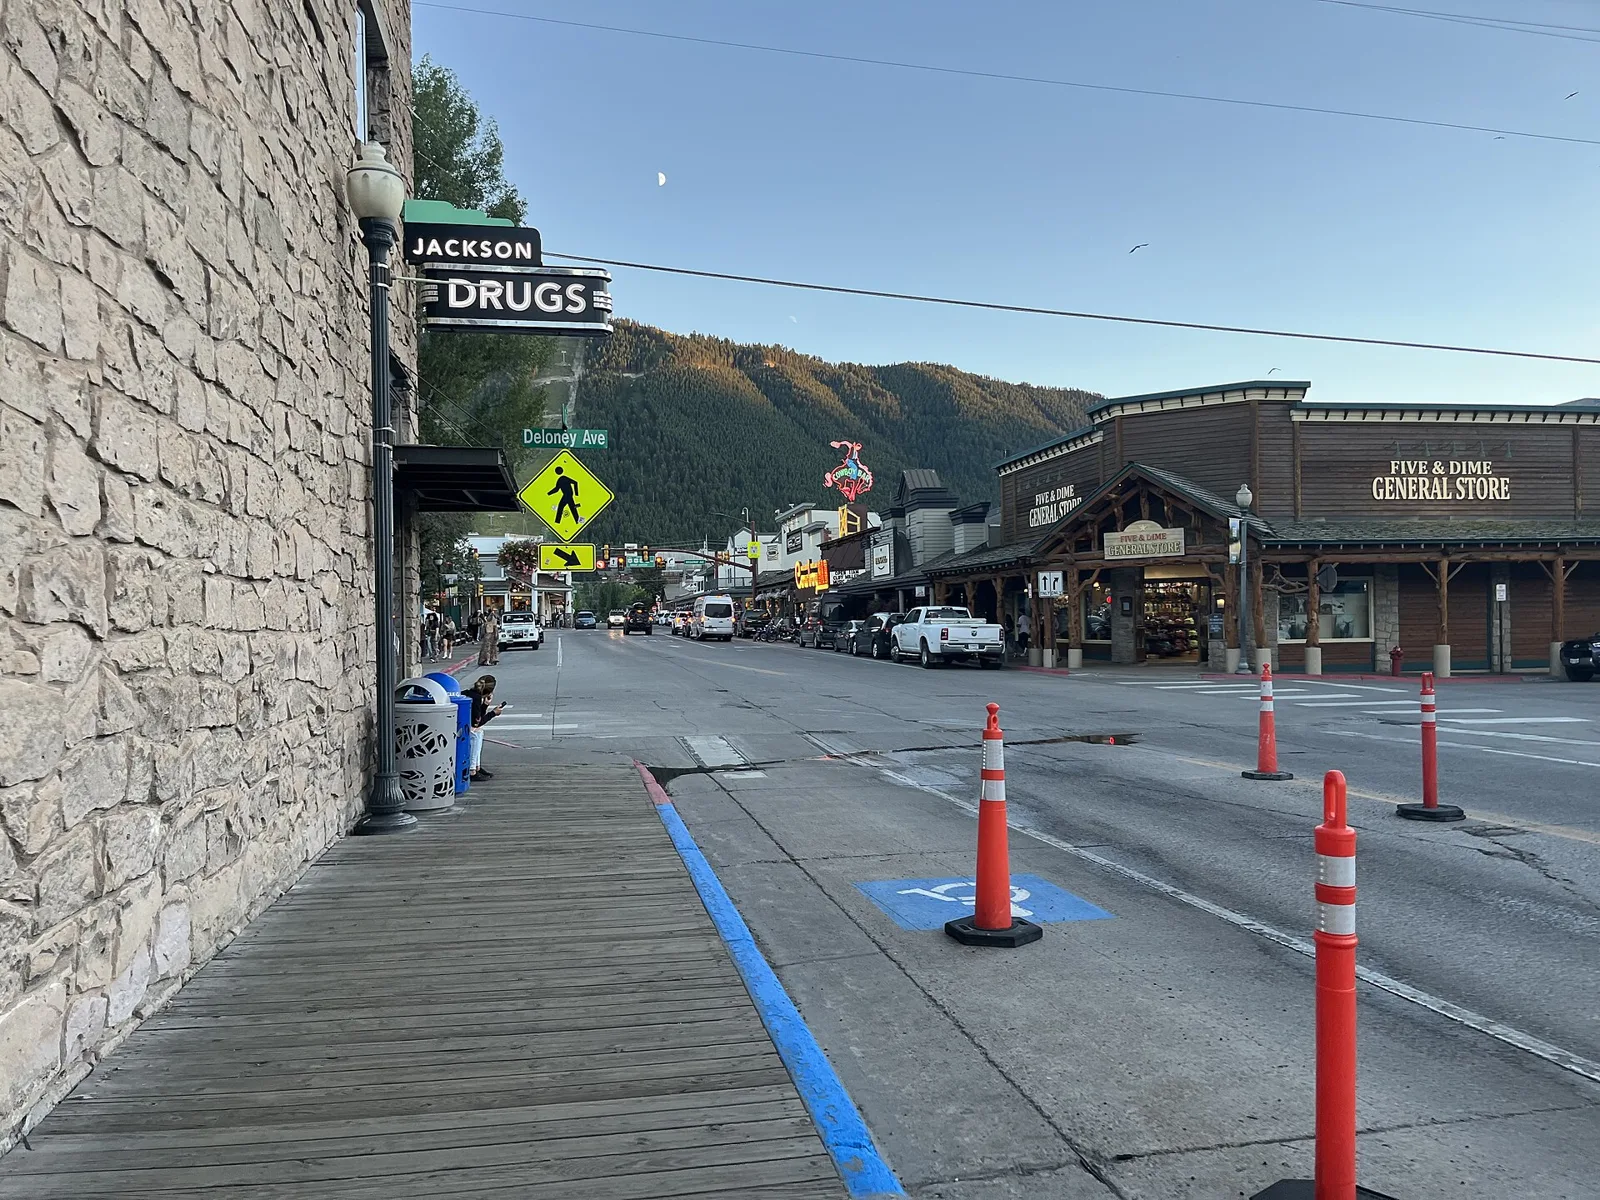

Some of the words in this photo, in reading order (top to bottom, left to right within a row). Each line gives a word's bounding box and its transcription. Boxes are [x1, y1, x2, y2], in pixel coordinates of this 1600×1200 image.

[412, 237, 532, 260] JACKSON
[448, 278, 587, 314] DRUGS
[523, 428, 577, 447] Deloney
[582, 429, 606, 445] Ave
[832, 467, 856, 481] COWBOY
[1390, 460, 1428, 475] FIVE
[1431, 460, 1446, 475] &
[1449, 460, 1492, 475] DIME
[1035, 491, 1050, 506] FIVE
[1050, 490, 1056, 502] &
[1056, 484, 1075, 501] DIME
[1372, 476, 1453, 500] GENERAL
[1455, 477, 1511, 500] STORE
[1029, 502, 1059, 527] GENERAL
[1058, 497, 1082, 519] STO
[1120, 534, 1138, 543] FIVE
[1139, 533, 1145, 542] &
[1108, 543, 1149, 557] GENERAL
[1150, 541, 1181, 555] STORE
